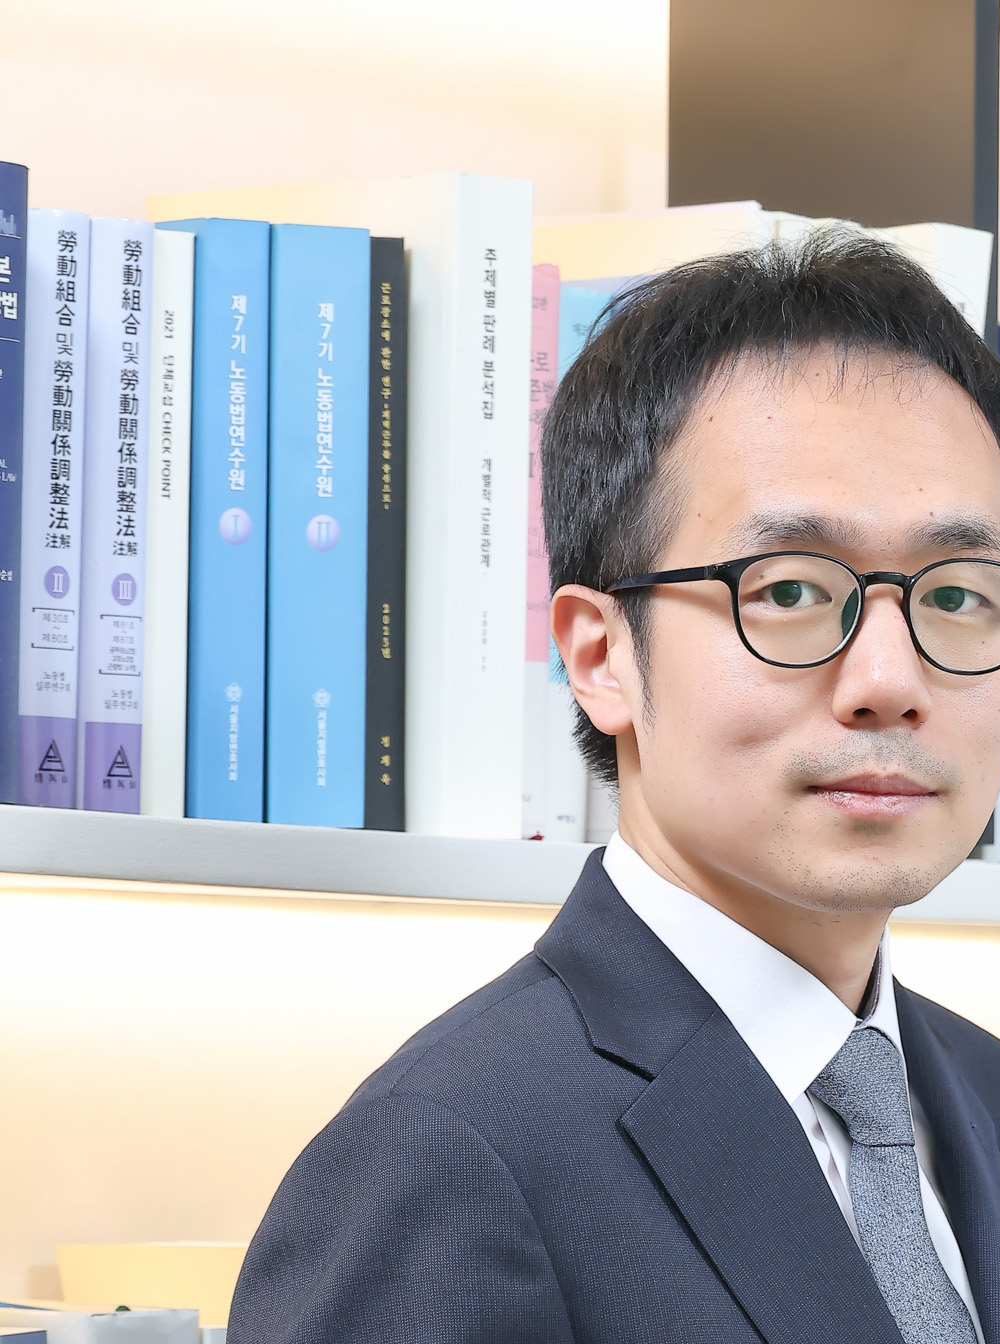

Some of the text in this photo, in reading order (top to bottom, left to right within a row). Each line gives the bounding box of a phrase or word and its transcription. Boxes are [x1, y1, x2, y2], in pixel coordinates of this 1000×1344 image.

[55, 230, 78, 327] 勞動組合
[122, 239, 143, 336] 勞動組合
[56, 332, 73, 356] 및
[121, 341, 139, 365] 및
[161, 310, 174, 500] 2021 단체교섭 CHECK POINT
[228, 295, 248, 491] 제7기 노동법연수원
[315, 302, 335, 498] 제7기 노동법연수원
